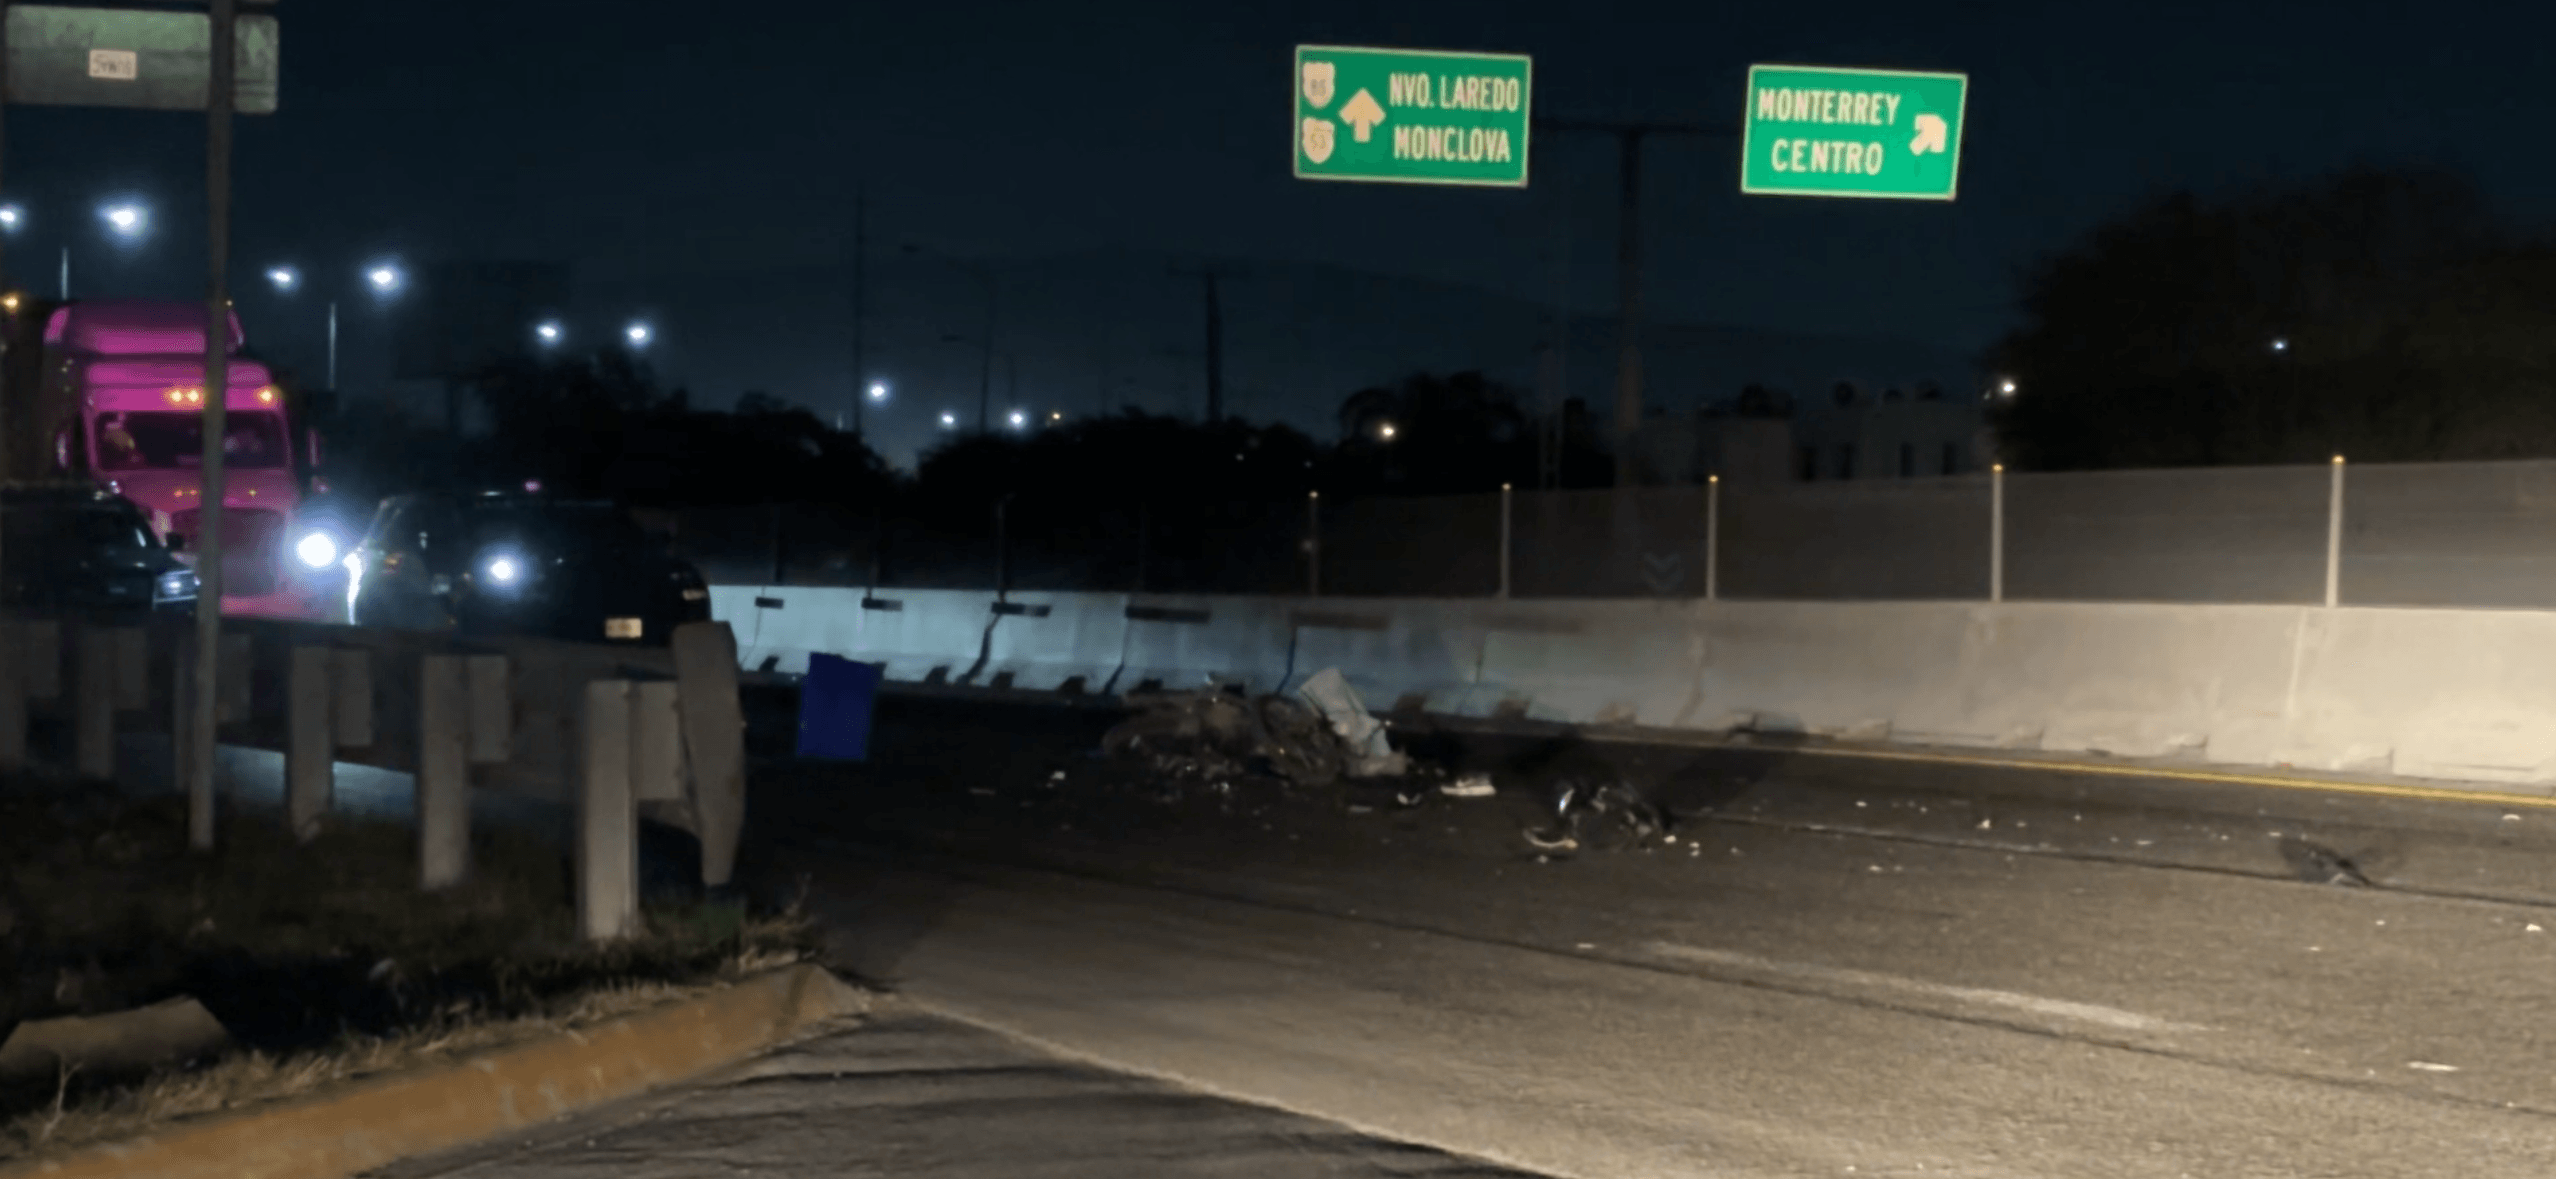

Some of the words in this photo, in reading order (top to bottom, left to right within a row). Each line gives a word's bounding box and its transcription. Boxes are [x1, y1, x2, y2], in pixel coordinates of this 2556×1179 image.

[1390, 73, 1435, 108] NVO.
[1440, 74, 1520, 112] LAREDO
[1757, 88, 1901, 125] MONTERREY
[1394, 125, 1512, 163] MONCLOVA
[1772, 139, 1883, 175] CENTRO
